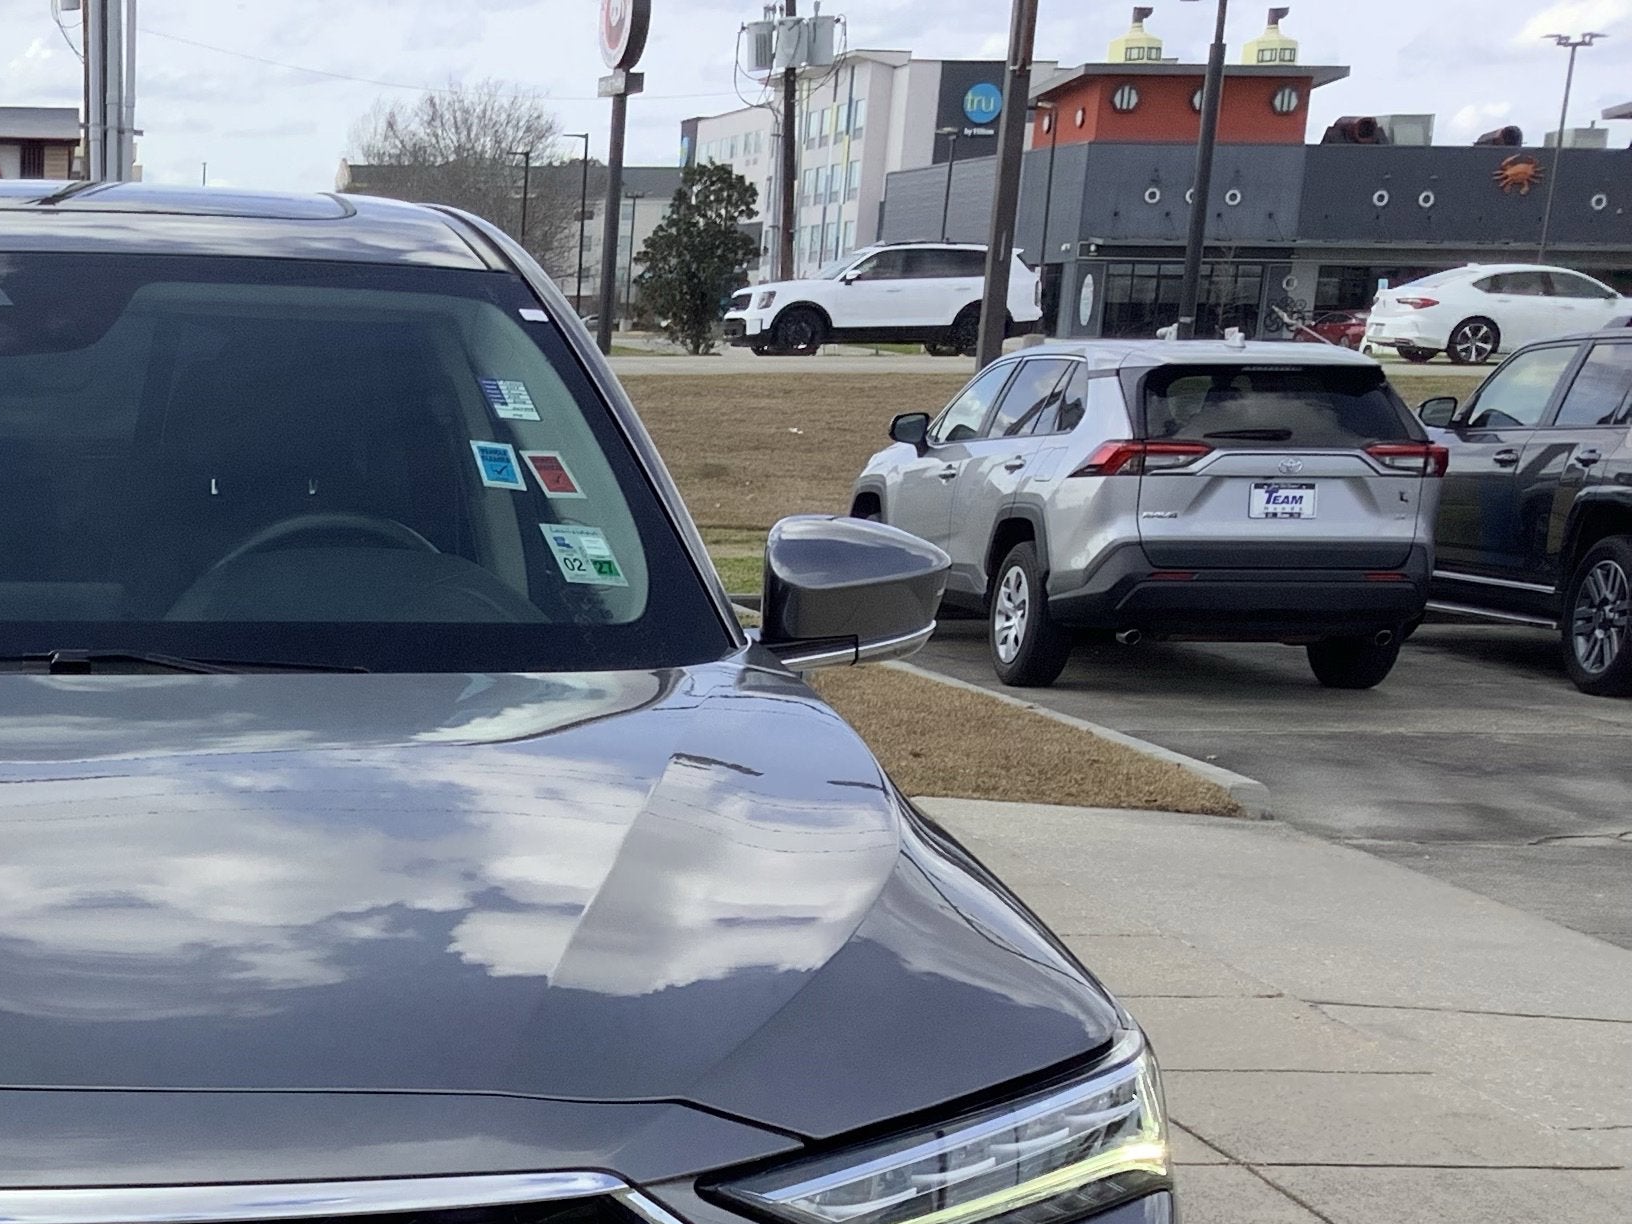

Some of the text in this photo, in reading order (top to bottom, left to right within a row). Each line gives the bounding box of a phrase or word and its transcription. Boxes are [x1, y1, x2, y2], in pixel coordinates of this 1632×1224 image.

[964, 92, 994, 112] tru
[1264, 486, 1304, 505] TEAM
[563, 557, 587, 572] 02
[593, 560, 614, 575] 27
